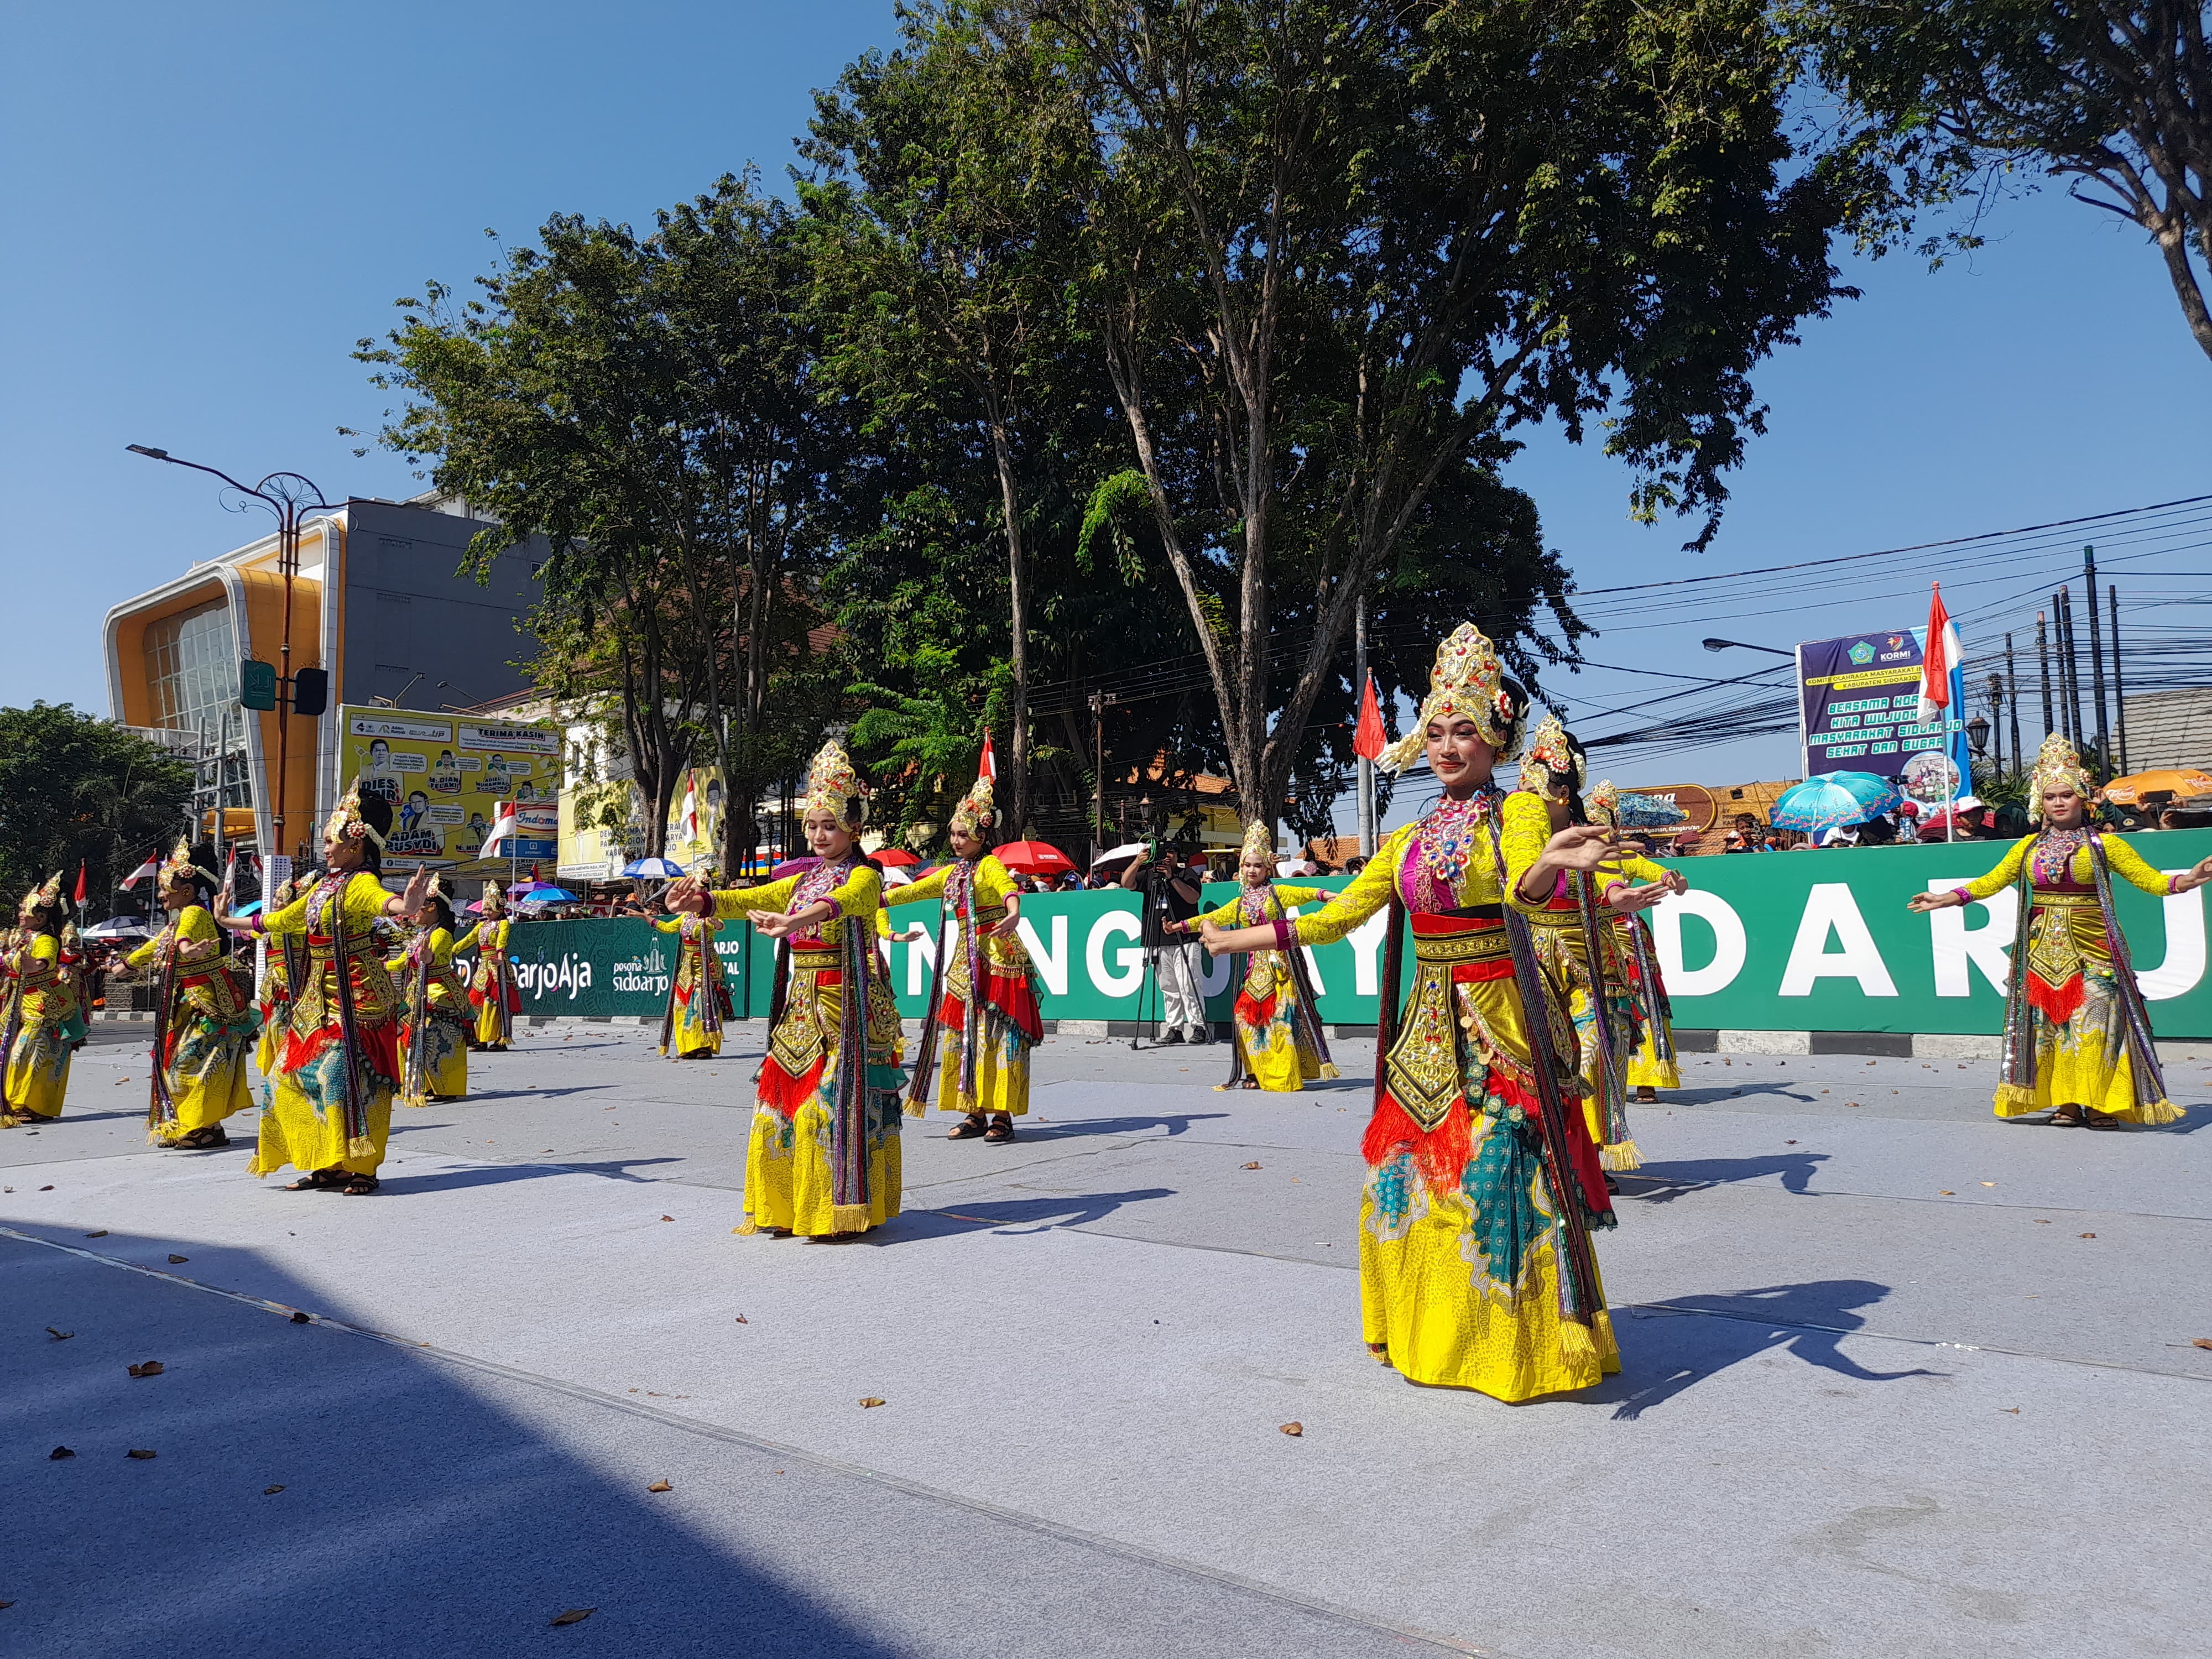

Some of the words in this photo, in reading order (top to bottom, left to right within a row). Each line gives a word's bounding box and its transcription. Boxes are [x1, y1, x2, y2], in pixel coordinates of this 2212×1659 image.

[1880, 650, 1911, 660] KORMI
[1833, 673, 1869, 681] OLAHRAGA
[1870, 668, 1914, 677] MASYARAKAT
[1828, 697, 1889, 714] BERSAMA
[1831, 715, 1860, 728] KITA
[478, 728, 514, 737] TERIMA
[516, 730, 544, 739] KASIH
[1809, 726, 1893, 745] MASYARAKAT
[1826, 744, 1867, 758] SEHAT
[1871, 741, 1897, 754] DAN
[362, 778, 395, 790] DIES
[390, 830, 432, 842] ADAM
[385, 839, 437, 852] RUSYDI
[613, 962, 643, 975] pesona
[612, 972, 669, 996] sidoarjo
